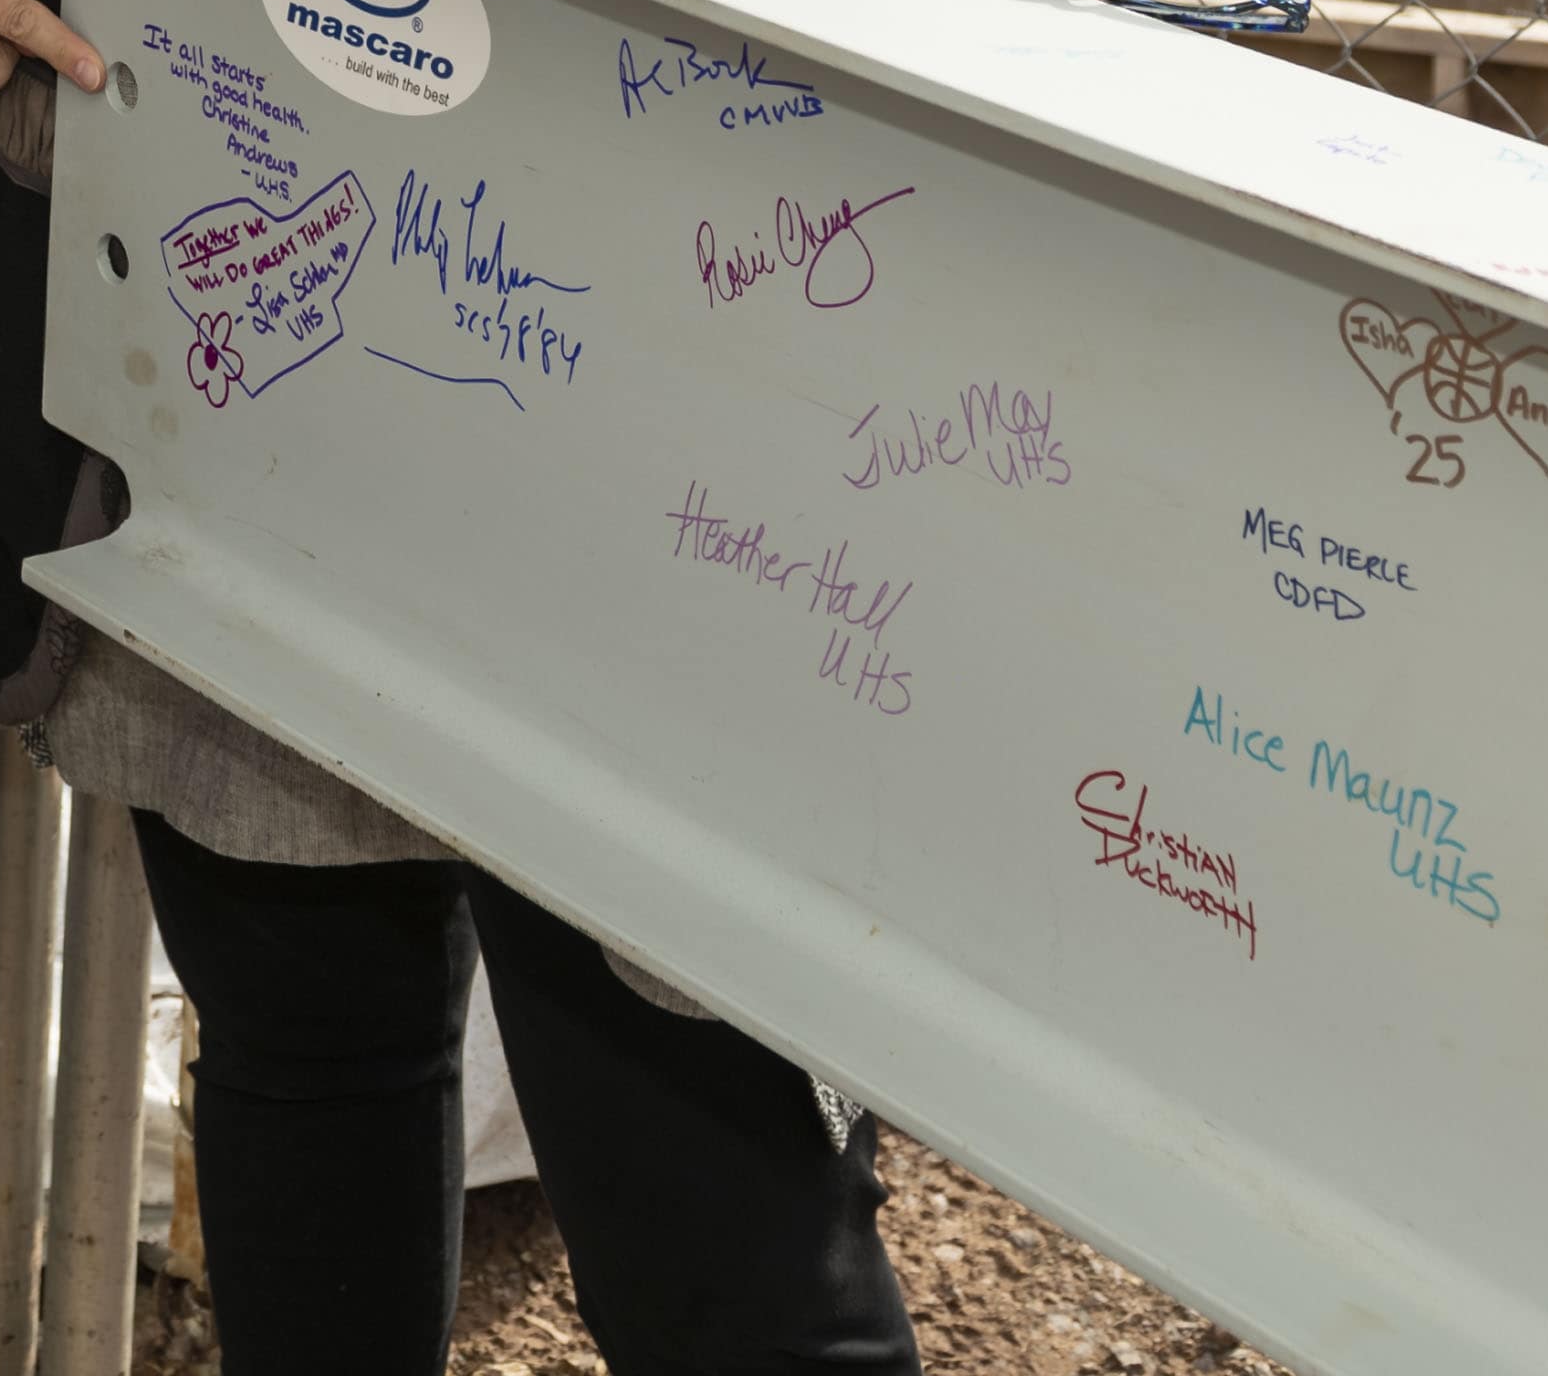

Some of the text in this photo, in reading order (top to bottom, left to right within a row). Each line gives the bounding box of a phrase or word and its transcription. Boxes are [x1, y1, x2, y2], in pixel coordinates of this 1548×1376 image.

[142, 24, 266, 92] It all starts
[286, 2, 454, 80] mascaro
[170, 62, 208, 89] with
[212, 81, 248, 108] good
[345, 56, 373, 79] build
[376, 70, 400, 89] with
[402, 78, 421, 96] the
[423, 85, 451, 107] best
[202, 95, 270, 143] Christine
[227, 133, 298, 178] Andrews
[185, 272, 224, 293] WILL
[224, 262, 248, 283] DO
[252, 234, 299, 275] GREAT
[286, 304, 325, 342] UHS
[1350, 315, 1415, 359] Isha
[842, 403, 969, 490] Julie
[987, 433, 1072, 490] UHS
[1242, 506, 1305, 557] MEG
[665, 479, 914, 651] Heather Hall
[818, 628, 914, 715] UHS
[1184, 685, 1467, 853] Alice Maunz
[1388, 828, 1502, 924] UHS
